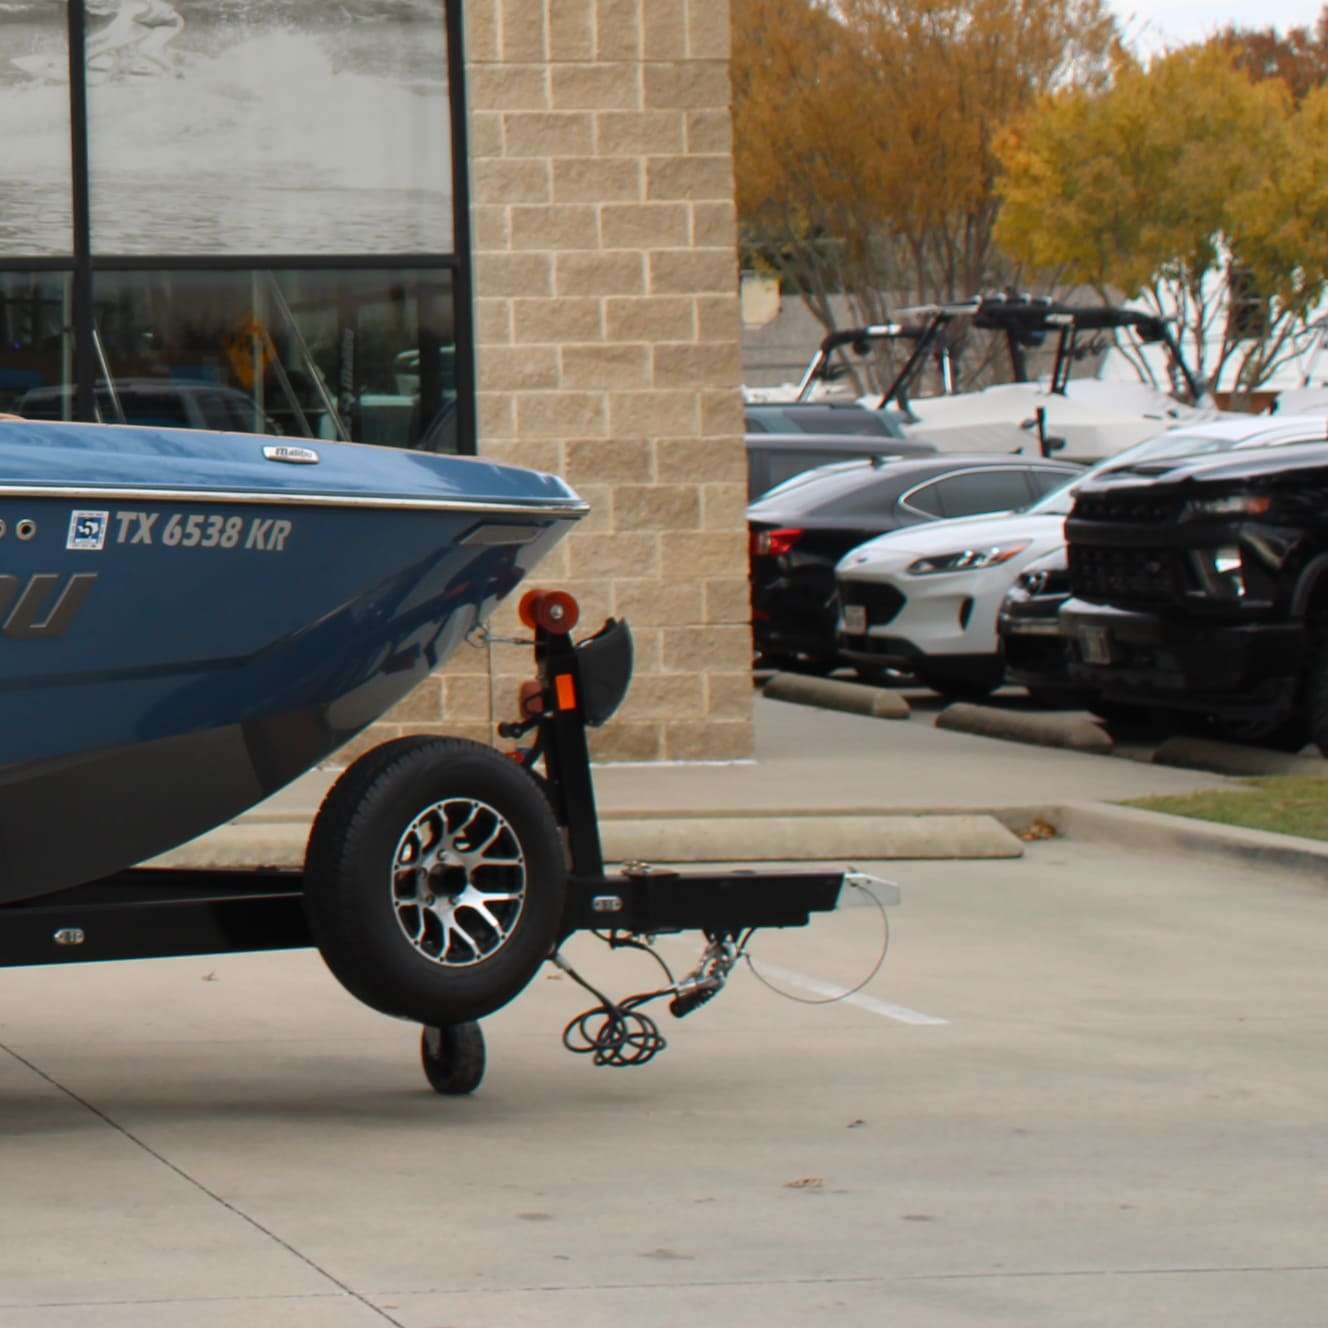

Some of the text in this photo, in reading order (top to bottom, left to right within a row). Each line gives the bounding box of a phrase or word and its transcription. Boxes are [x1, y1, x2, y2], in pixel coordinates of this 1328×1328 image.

[115, 512, 292, 551] TX 6538 KR
